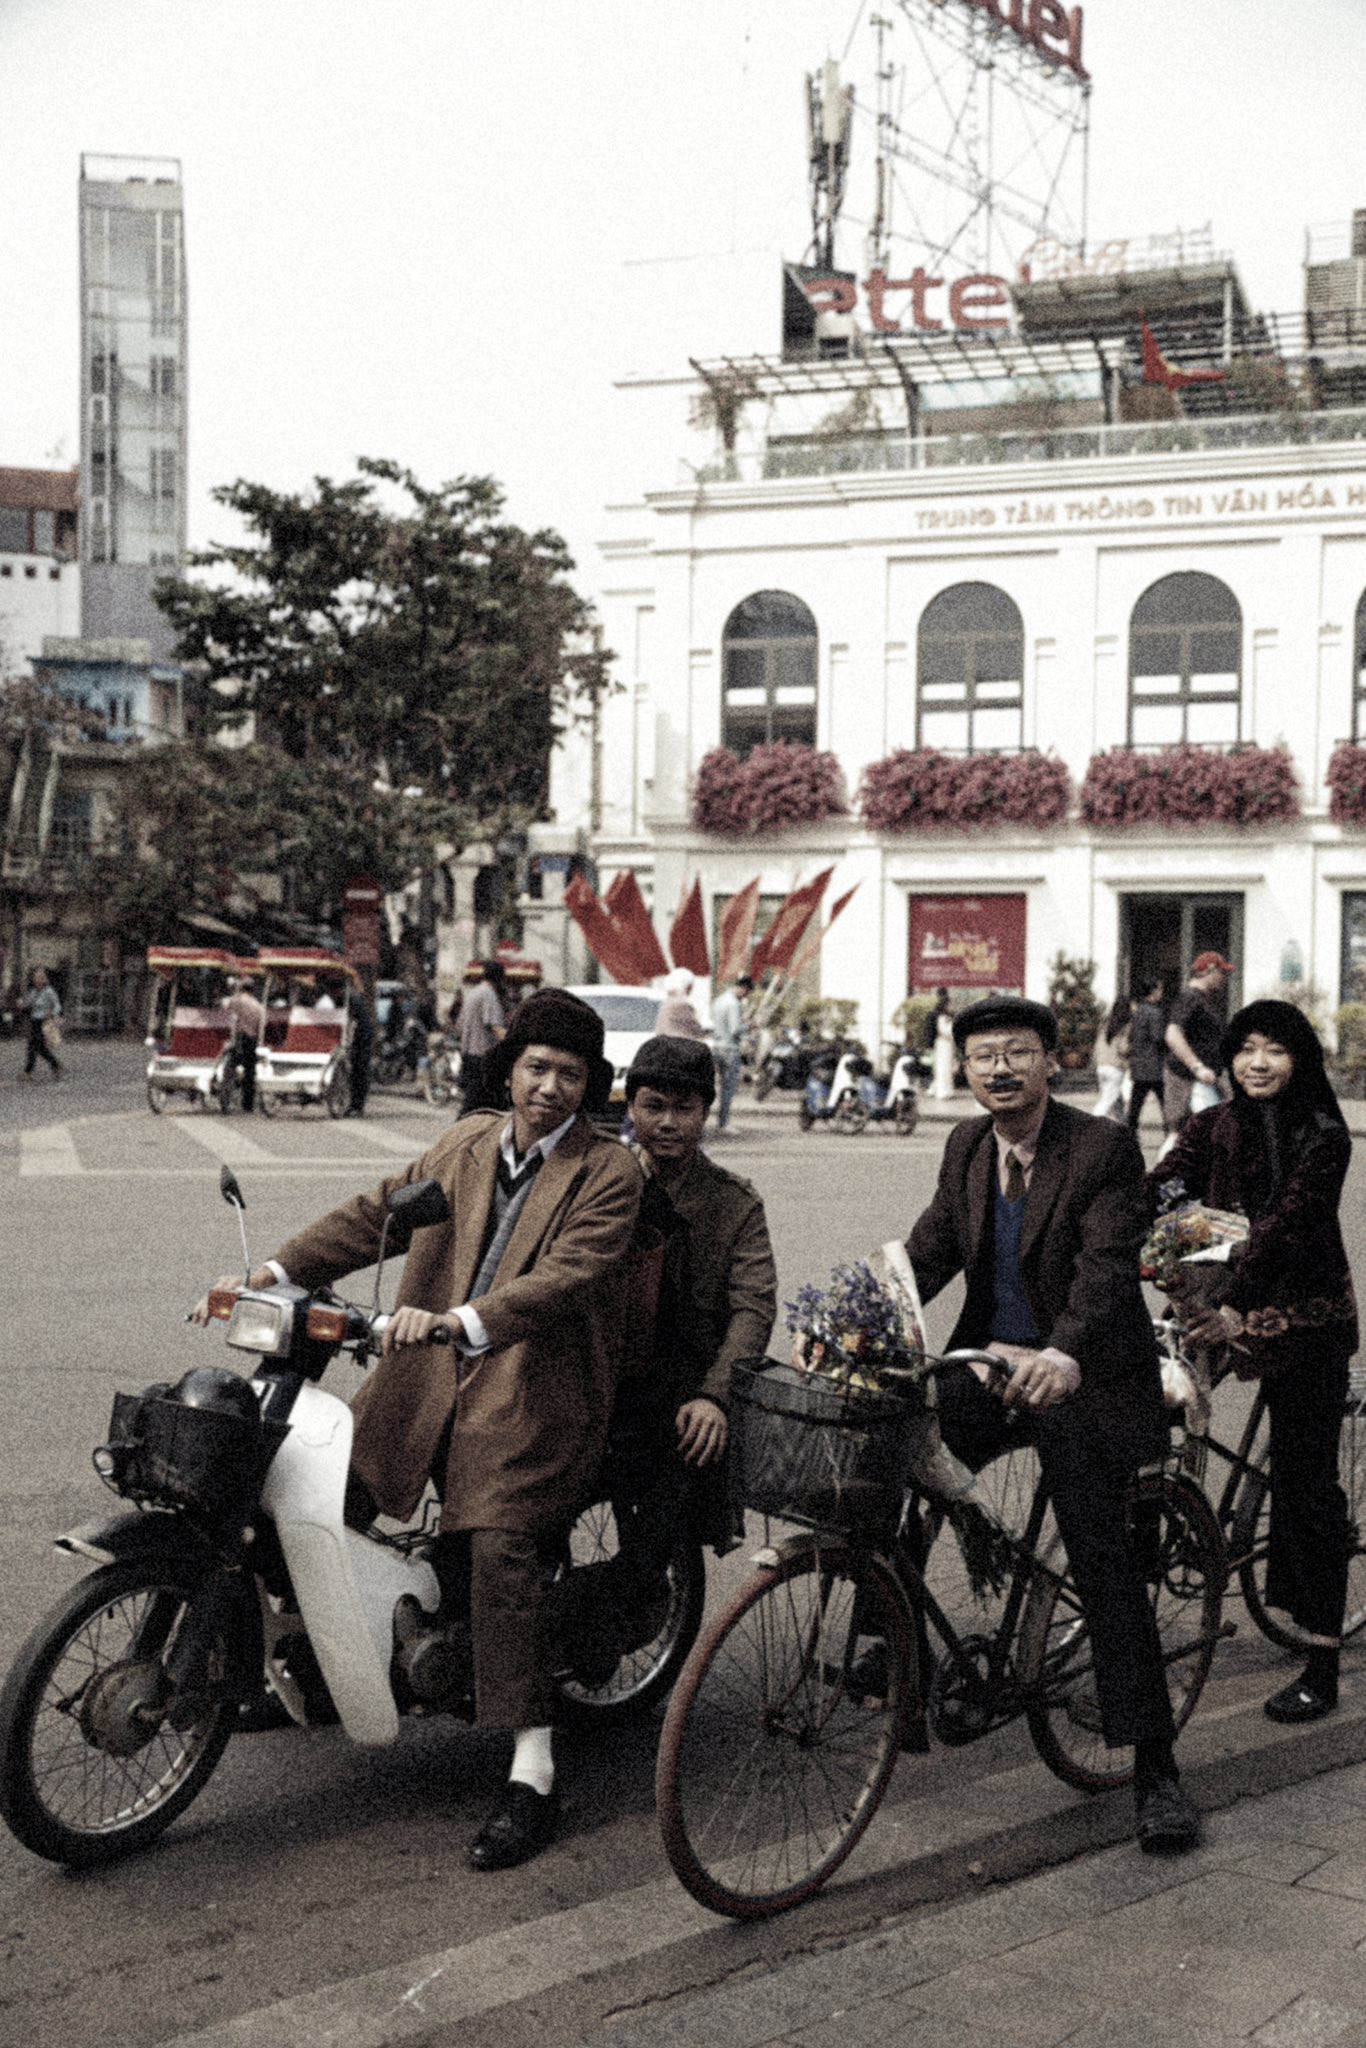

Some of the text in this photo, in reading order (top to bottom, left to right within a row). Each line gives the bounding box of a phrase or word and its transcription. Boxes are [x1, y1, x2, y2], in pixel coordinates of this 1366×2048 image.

[914, 508, 995, 529] TRUNG
[1004, 500, 1055, 524] TÂM
[1064, 495, 1154, 521] THÔNG
[1163, 496, 1202, 516] TIN
[1277, 481, 1337, 510] HÓA
